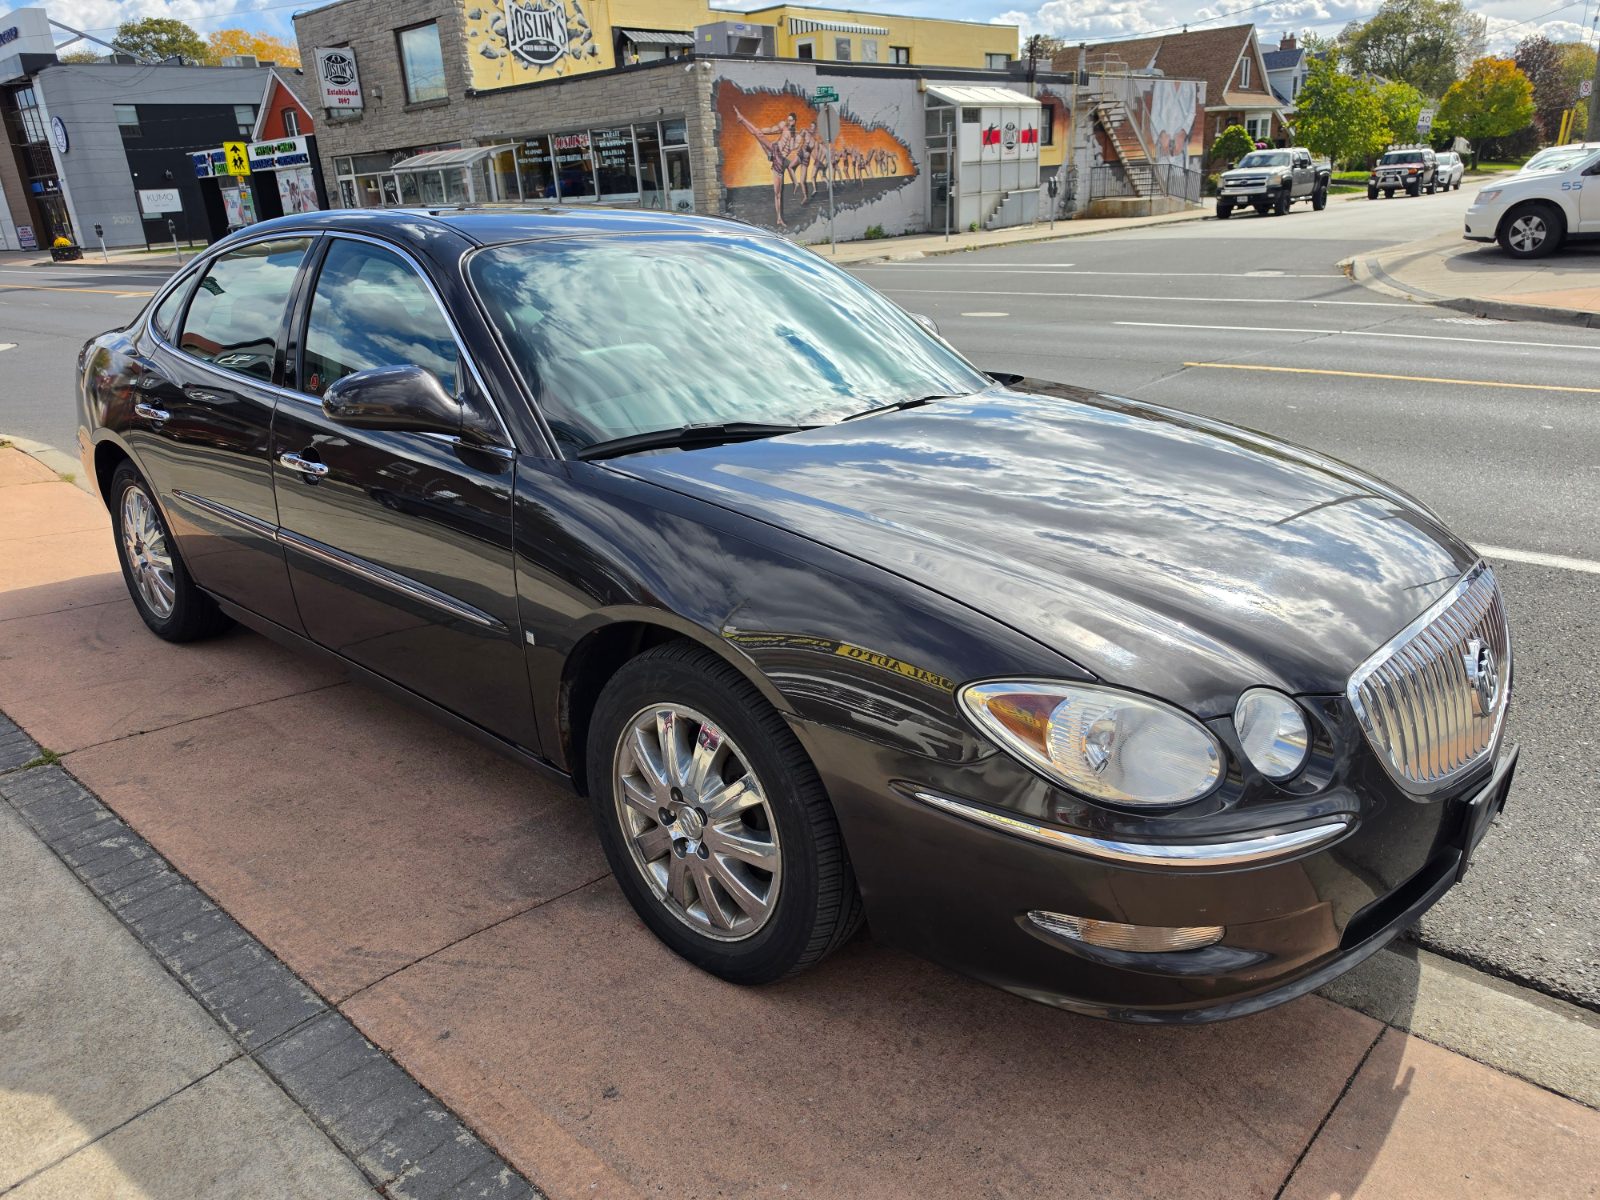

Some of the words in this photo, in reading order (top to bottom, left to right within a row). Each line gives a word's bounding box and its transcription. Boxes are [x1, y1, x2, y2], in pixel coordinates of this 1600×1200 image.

[508, 4, 567, 46] JOSLIN'S
[323, 59, 354, 80] JOSLIN'S
[327, 88, 359, 96] Established
[146, 192, 174, 202] KUMO
